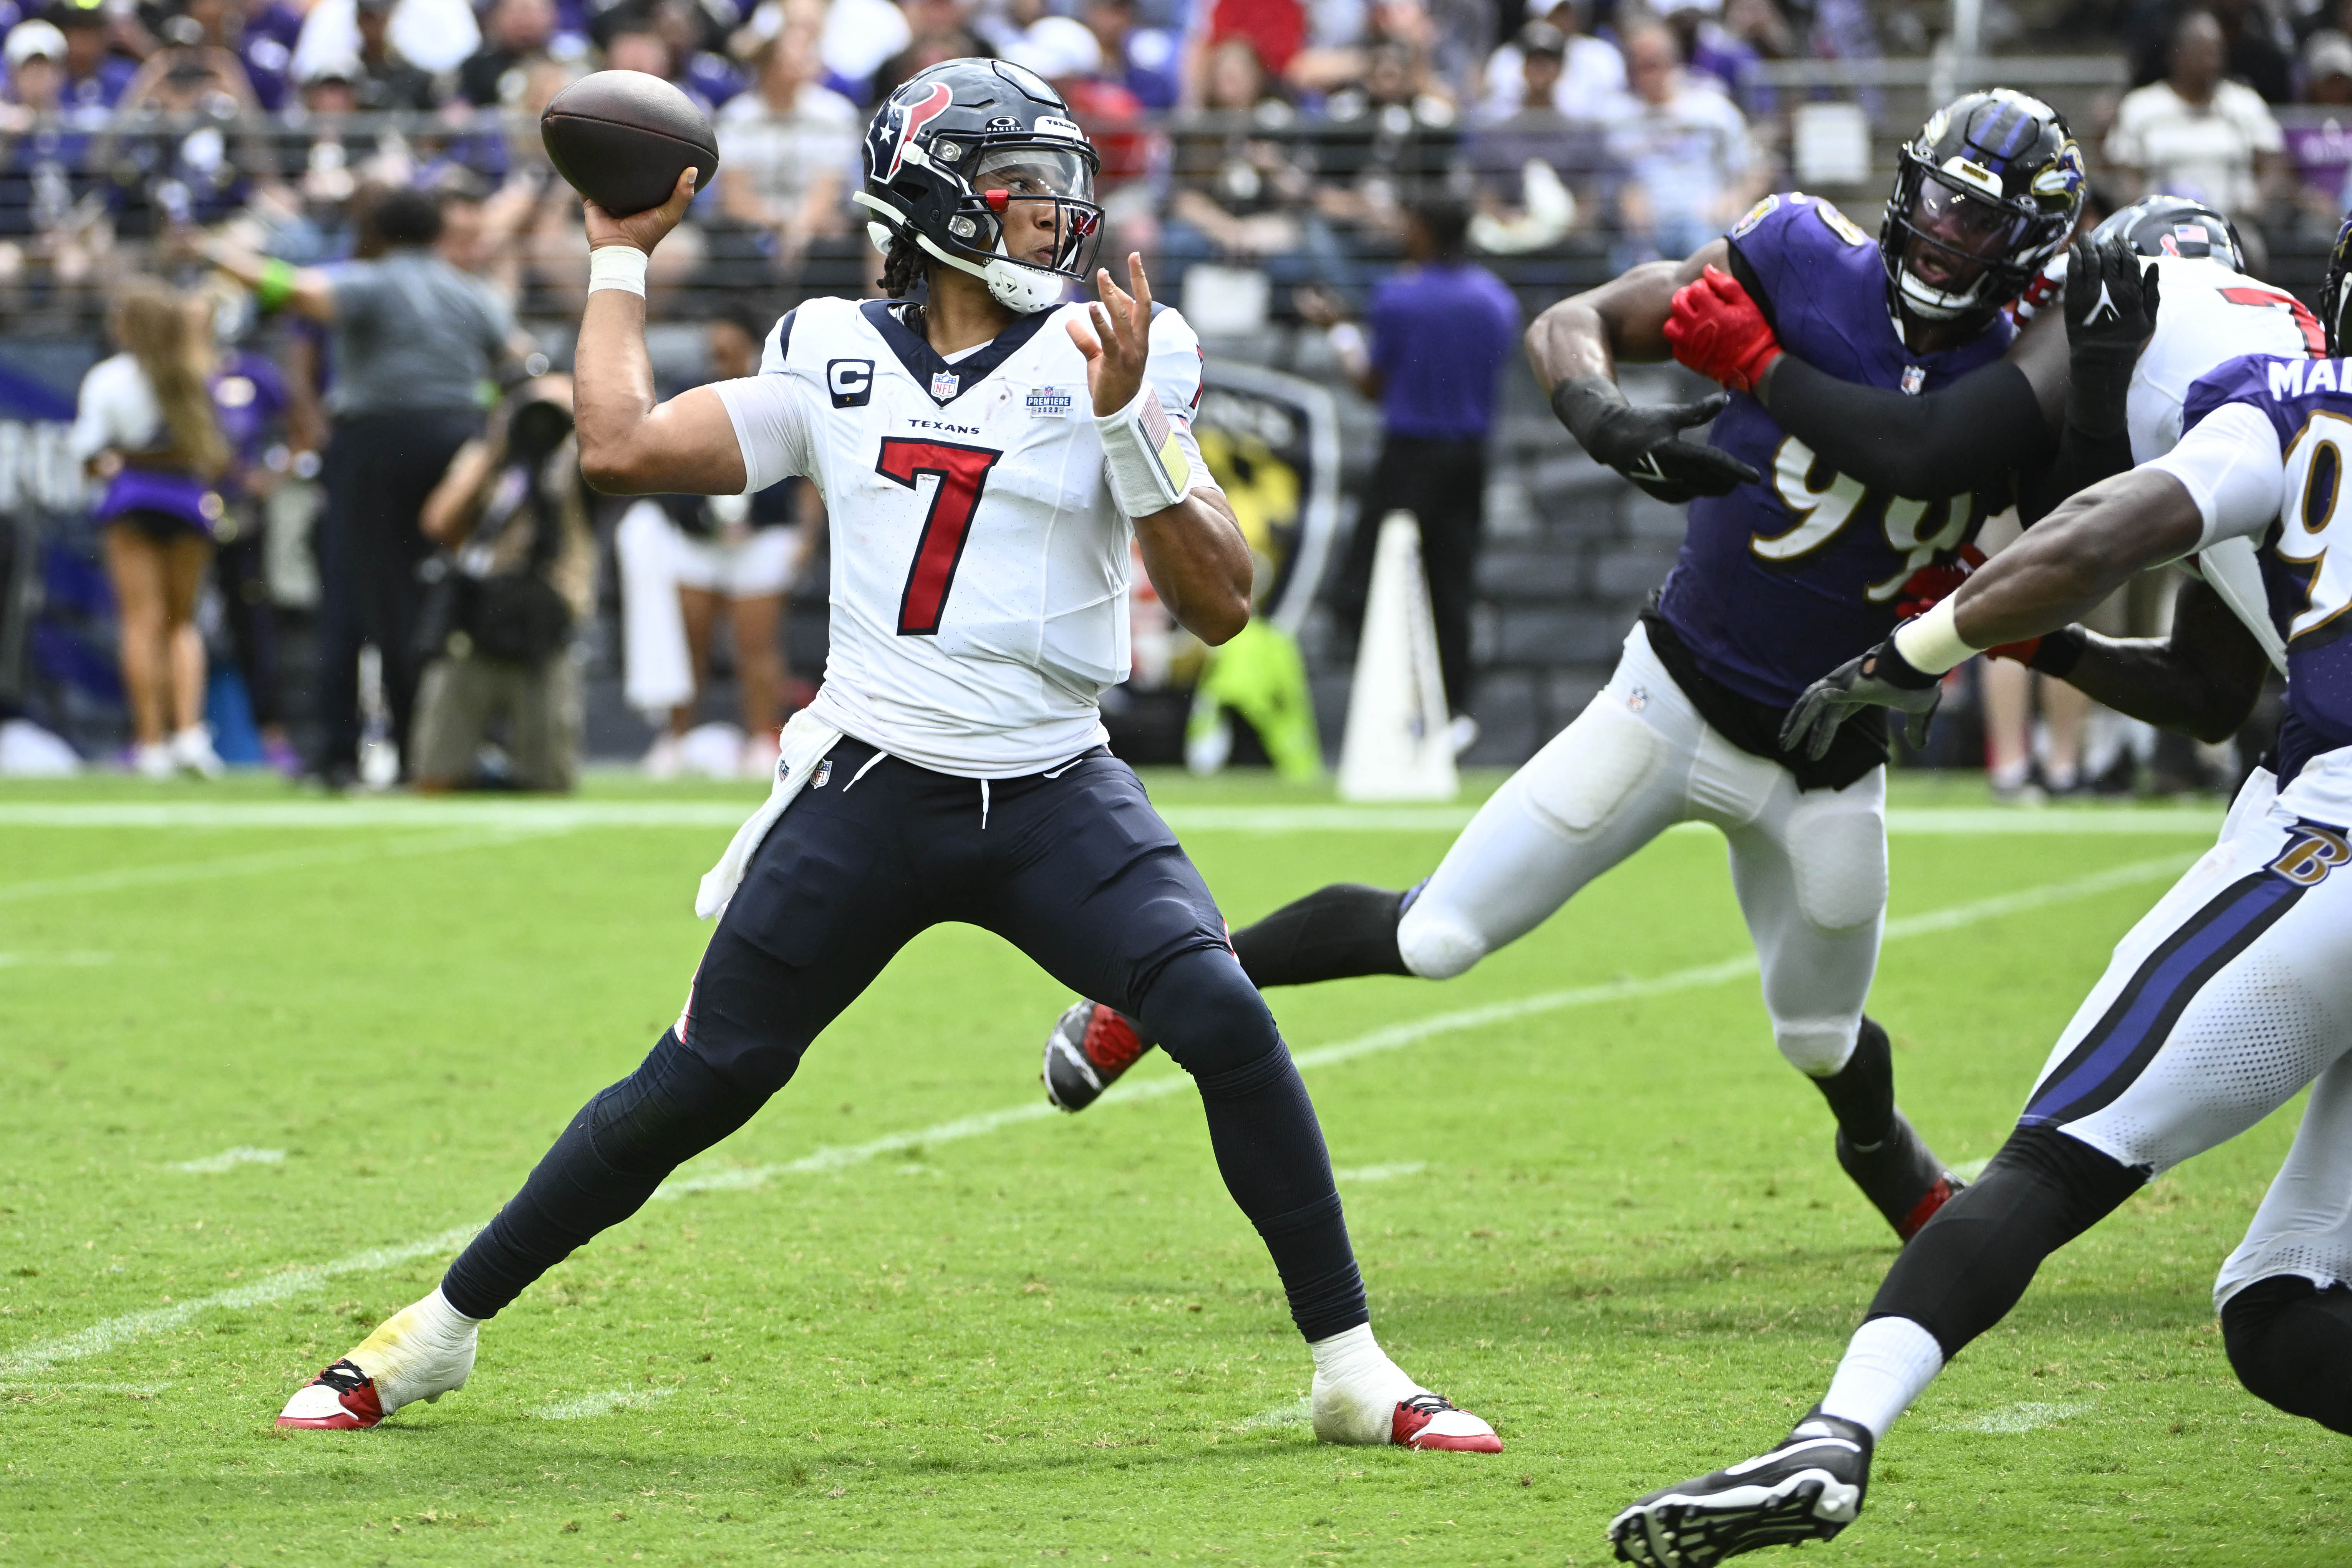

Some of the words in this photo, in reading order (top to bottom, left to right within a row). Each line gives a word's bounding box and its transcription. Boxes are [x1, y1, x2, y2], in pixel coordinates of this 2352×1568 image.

[1046, 119, 1077, 131] TEXANS
[830, 361, 870, 395] C
[935, 383, 953, 395] NFL
[1028, 398, 1069, 406] PREM1ERE
[908, 419, 981, 434] TEXANS
[875, 436, 1004, 636] 7
[812, 770, 825, 783] NFL
[2269, 826, 2352, 886] B
